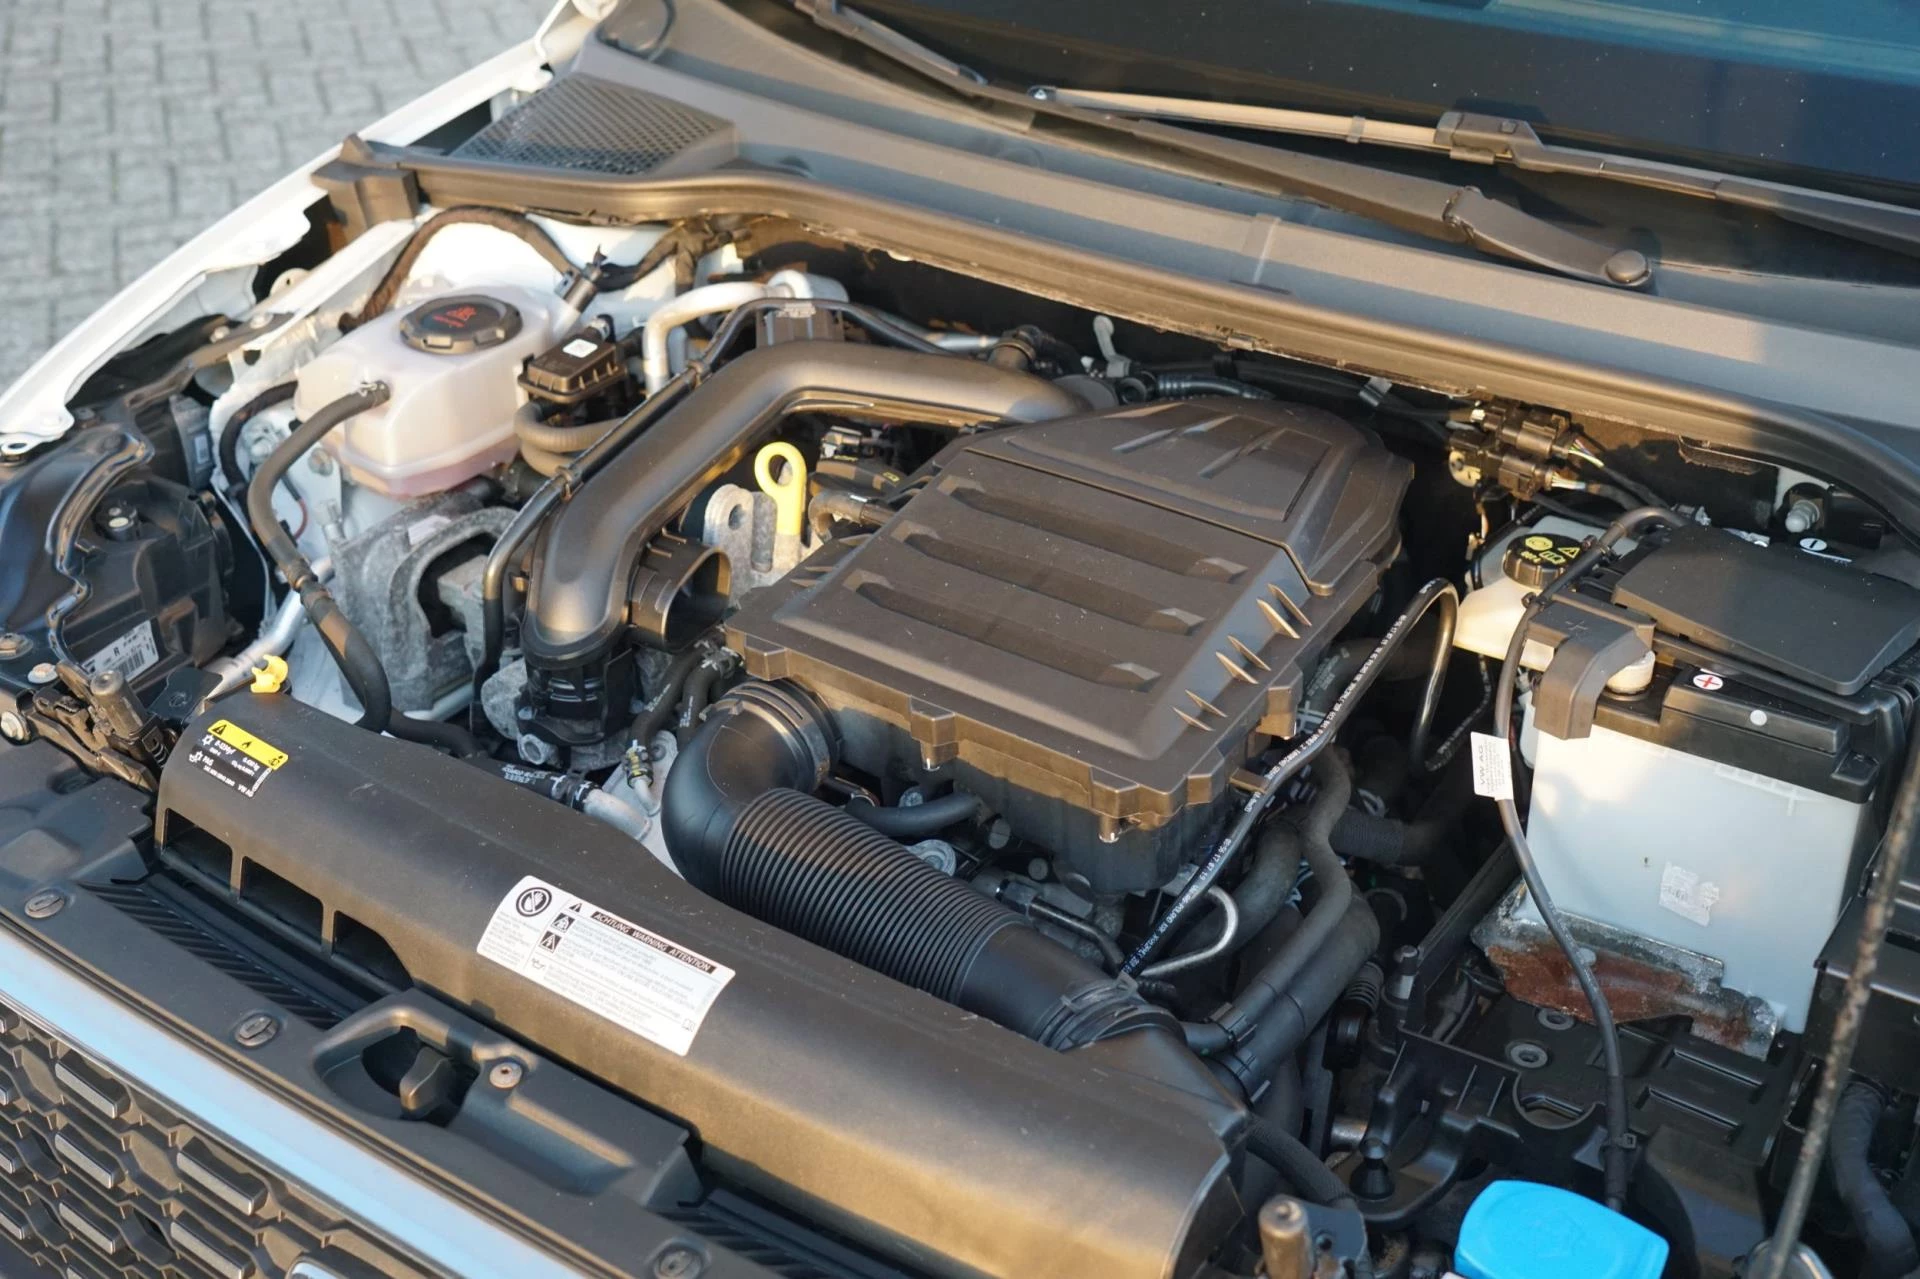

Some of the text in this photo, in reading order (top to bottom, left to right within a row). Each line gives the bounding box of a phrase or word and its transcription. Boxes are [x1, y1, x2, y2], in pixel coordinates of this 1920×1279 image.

[593, 913, 631, 934] ACHTUNG
[632, 930, 668, 951] WARNING
[669, 948, 711, 972] ATTENTION
